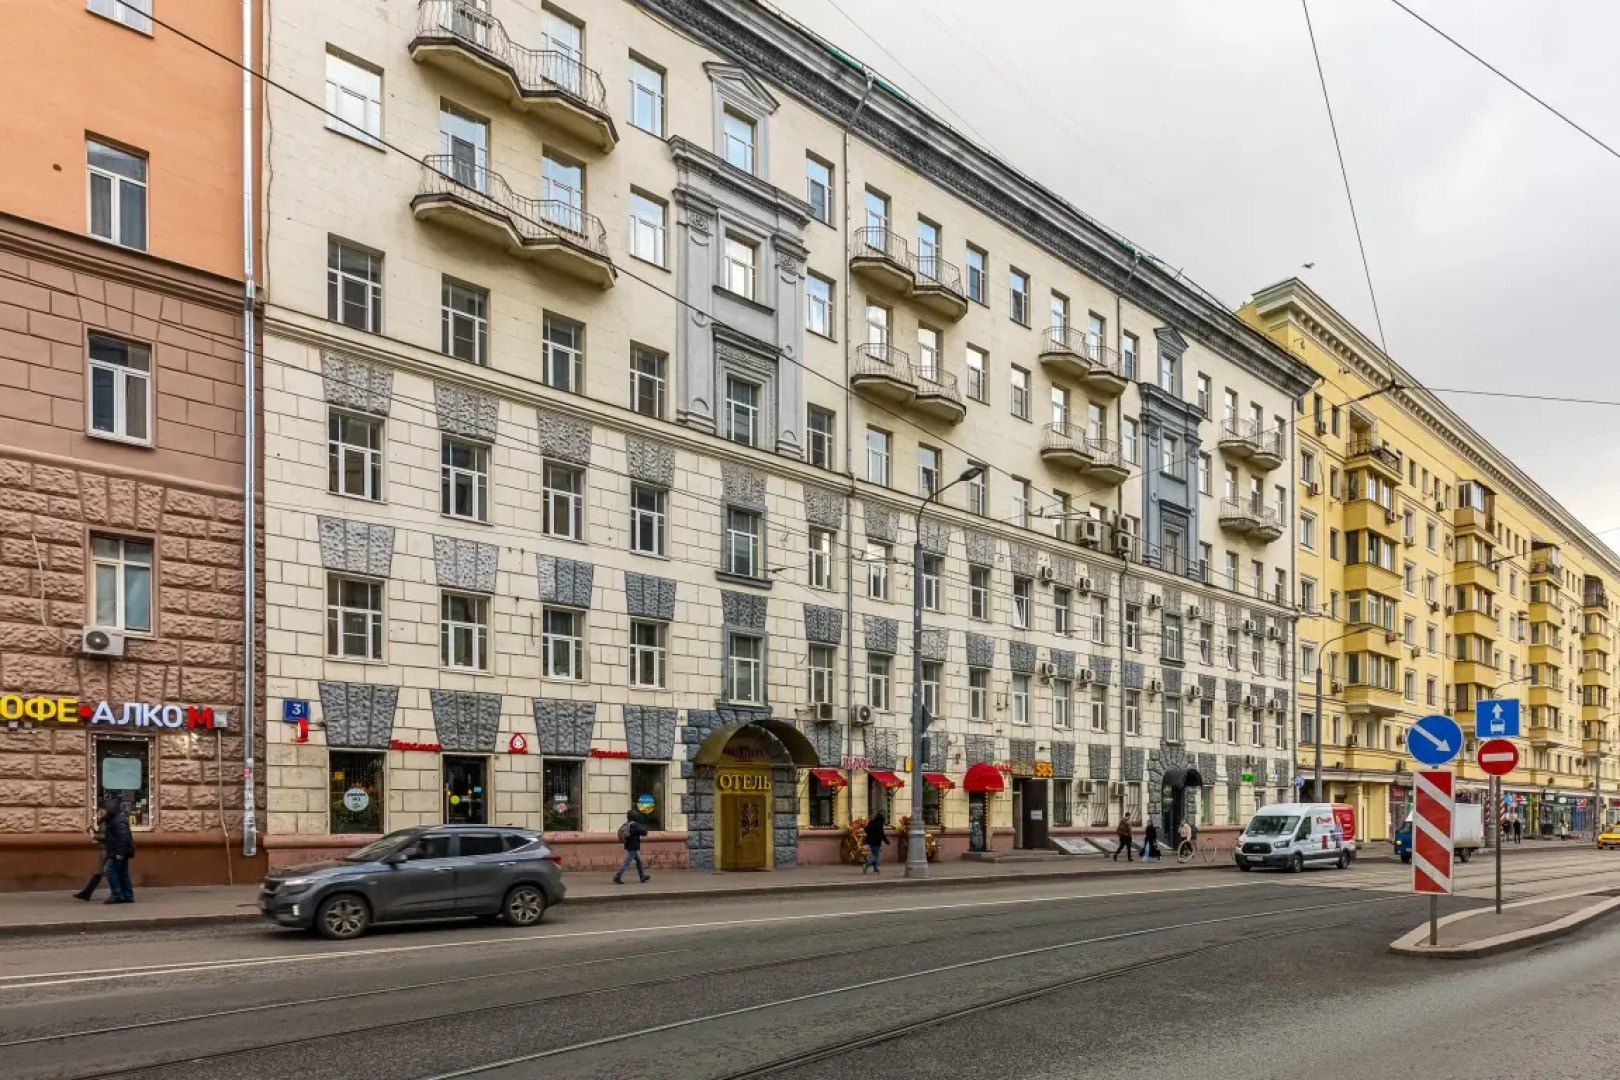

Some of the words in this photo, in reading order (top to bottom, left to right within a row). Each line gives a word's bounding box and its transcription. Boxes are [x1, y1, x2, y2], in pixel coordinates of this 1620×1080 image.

[91, 701, 183, 728] АЛКО
[292, 703, 302, 715] 3
[719, 774, 772, 790] ОТЕЛЬ
